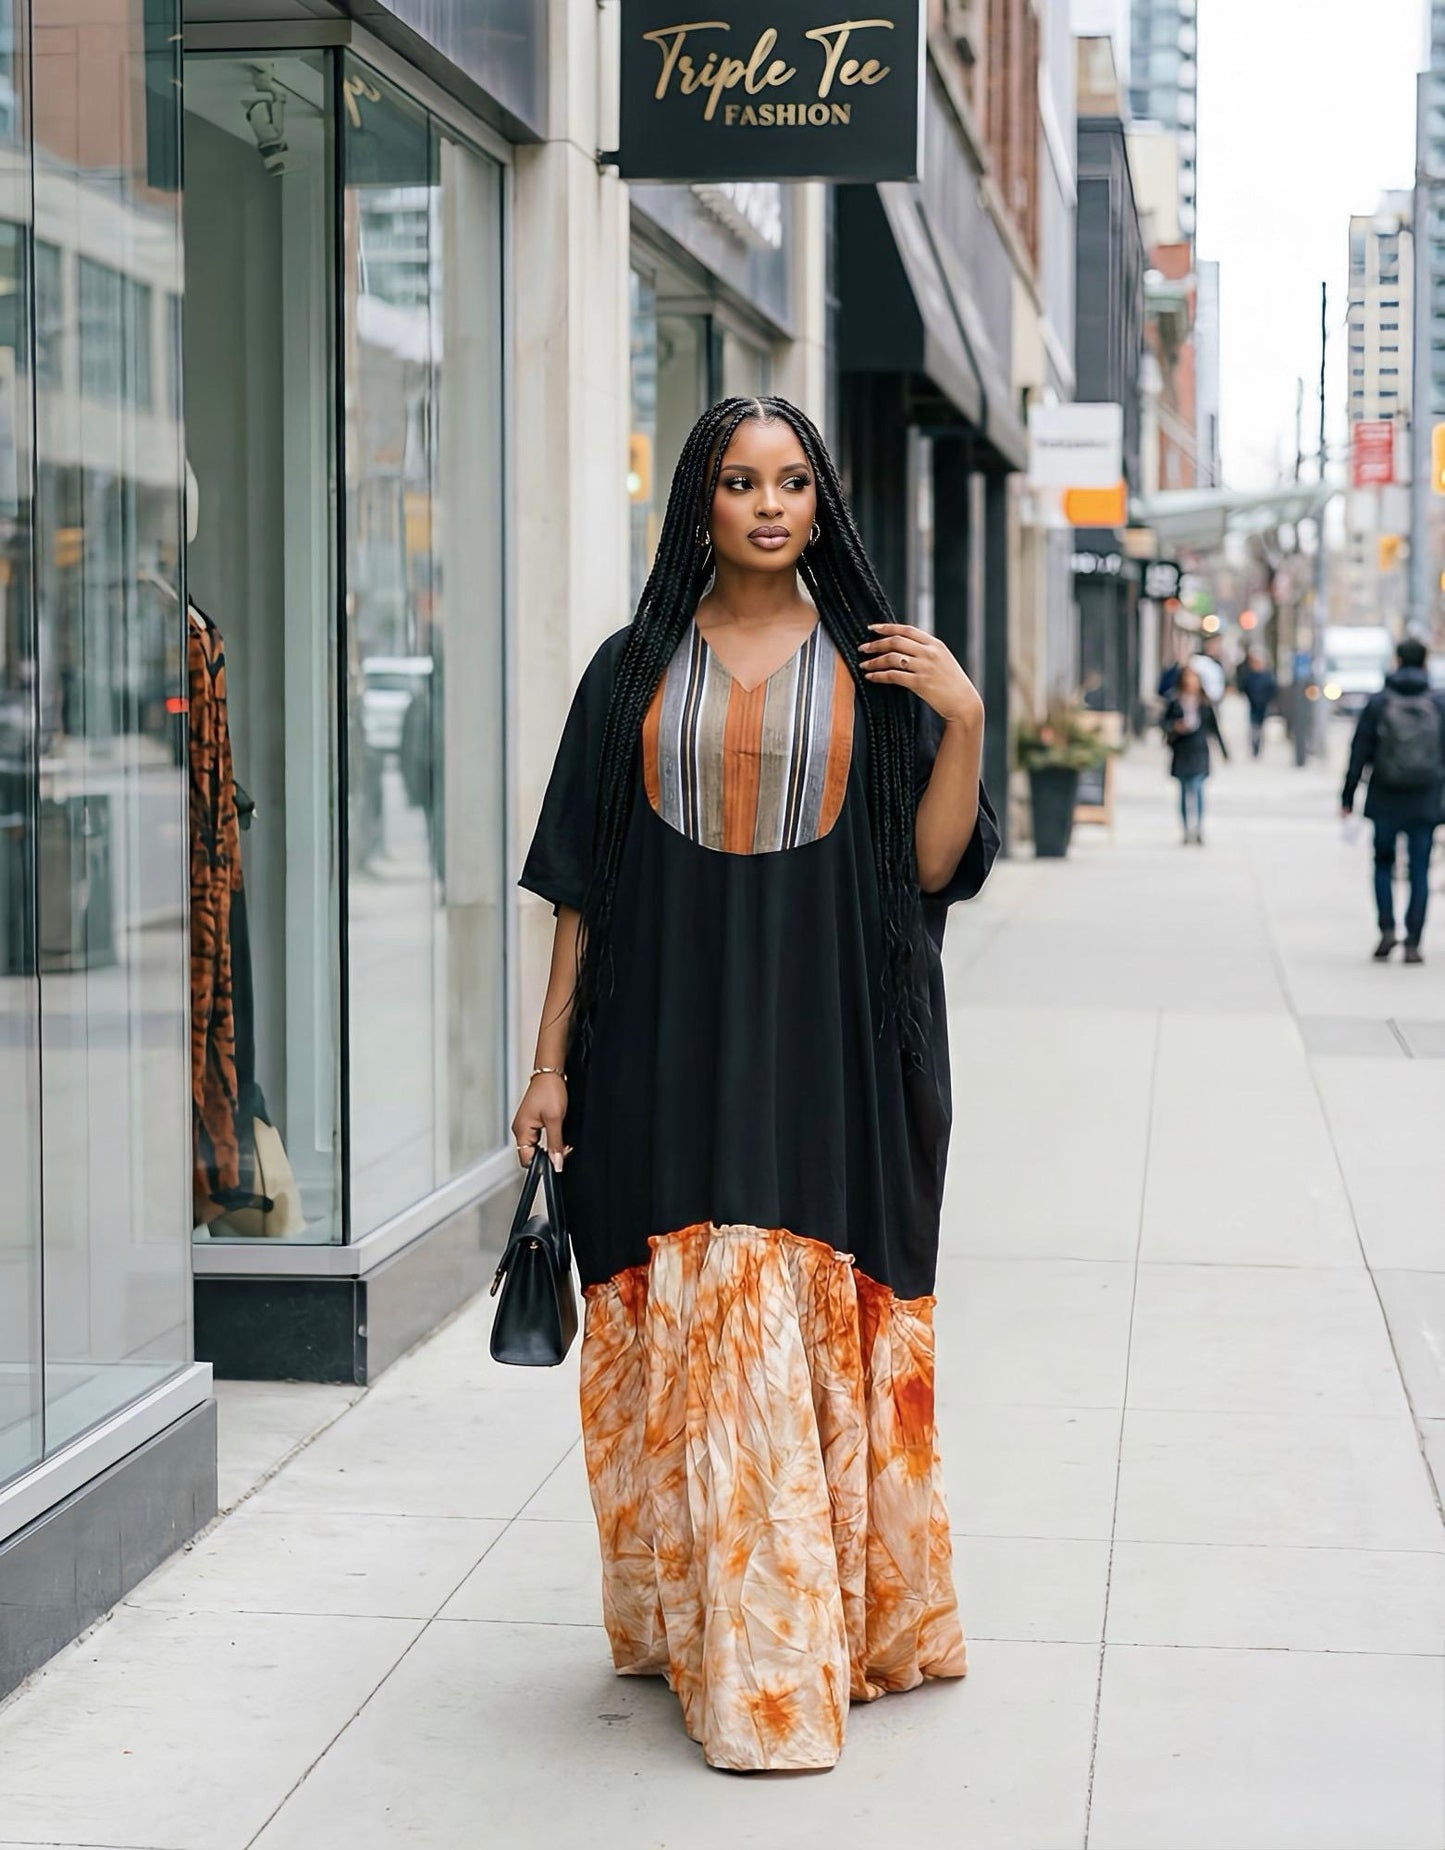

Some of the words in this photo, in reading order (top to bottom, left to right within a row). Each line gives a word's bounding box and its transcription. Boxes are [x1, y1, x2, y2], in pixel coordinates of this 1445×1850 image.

[642, 21, 797, 121] Triple
[805, 19, 895, 98] Tee
[724, 103, 851, 126] FASHION
